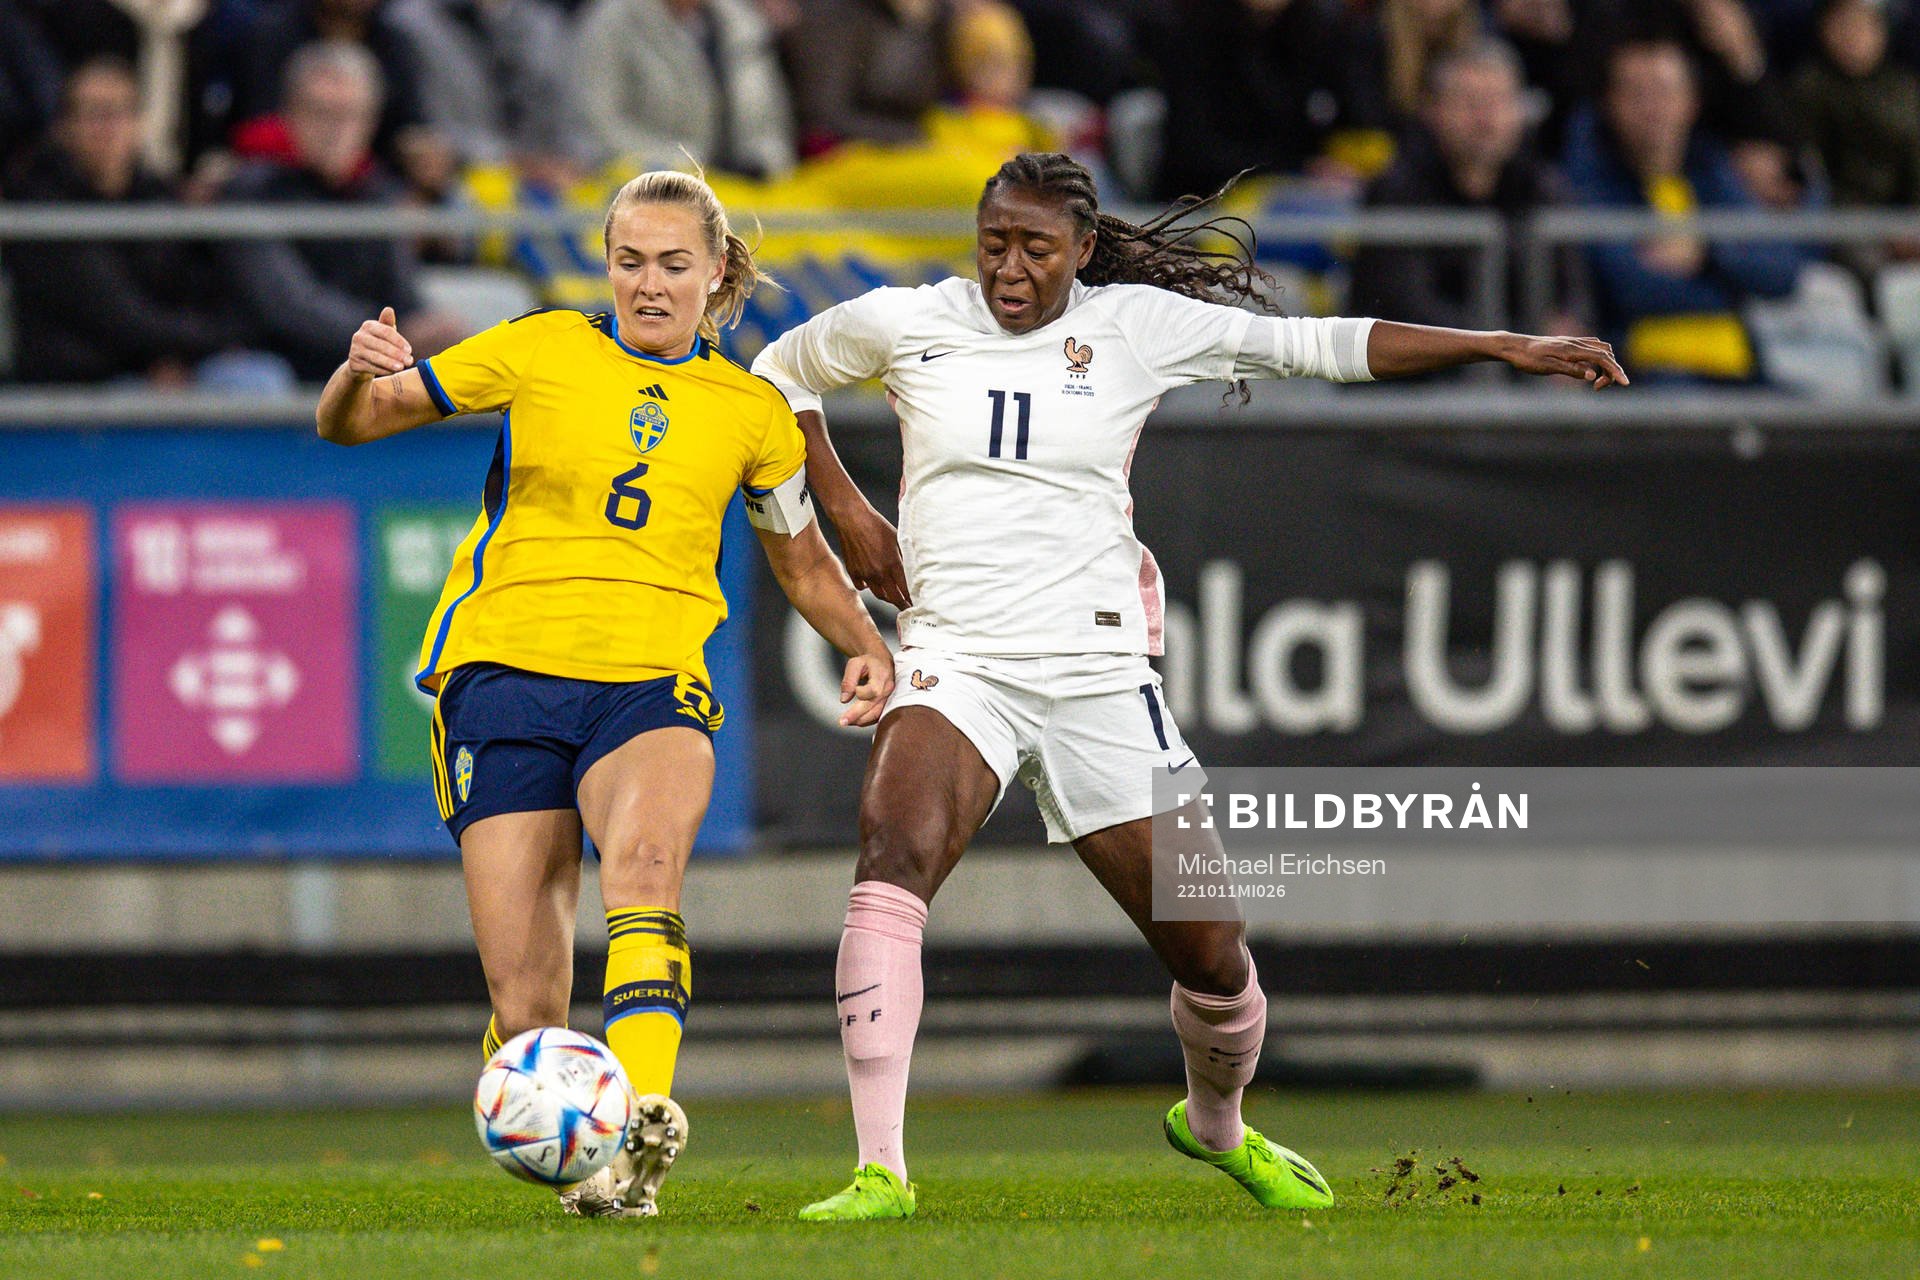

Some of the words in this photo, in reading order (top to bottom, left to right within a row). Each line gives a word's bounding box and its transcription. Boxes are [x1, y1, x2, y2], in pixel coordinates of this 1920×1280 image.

[988, 389, 1031, 460] 11
[604, 461, 652, 531] 6
[1403, 556, 1887, 736] Ullevi
